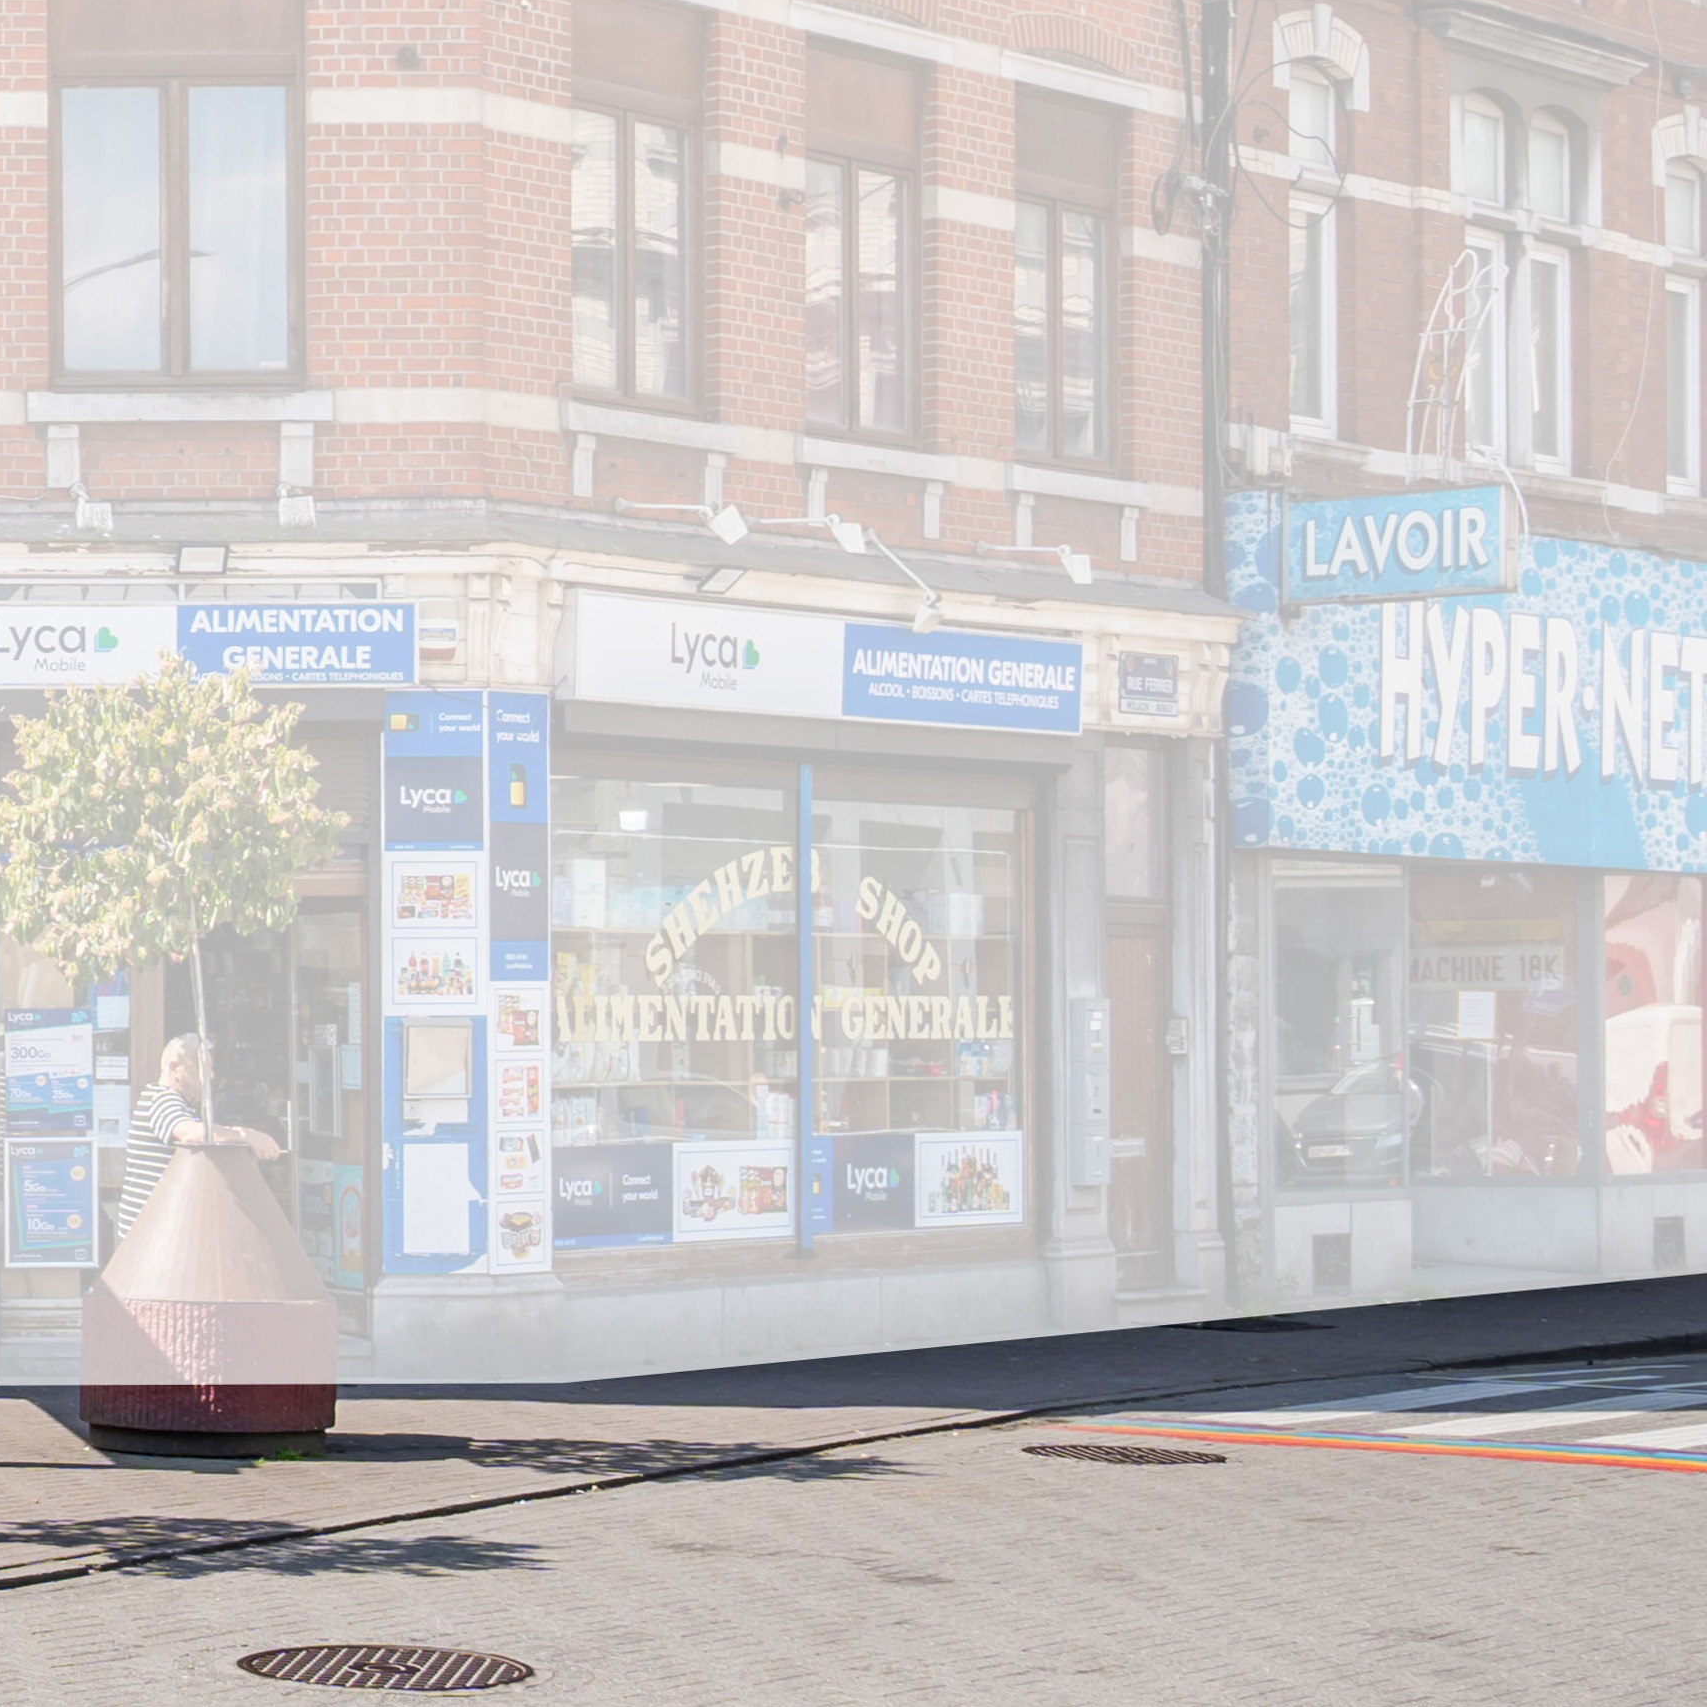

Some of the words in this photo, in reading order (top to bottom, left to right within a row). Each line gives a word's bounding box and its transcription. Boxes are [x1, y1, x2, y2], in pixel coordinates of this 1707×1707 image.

[1303, 506, 1489, 581] LAVOIR
[190, 608, 405, 633] ALIMENTATION
[223, 646, 372, 669] GENERALE
[670, 621, 738, 674] Lyca
[34, 657, 87, 672] Mobile
[852, 649, 984, 683] ALIMENTATION
[988, 660, 1076, 691] GENERALE
[291, 672, 327, 681] CARTES
[329, 672, 405, 681] TELEPHONIQUES
[701, 671, 737, 692] Mobile
[1127, 676, 1143, 691] RUE
[868, 682, 905, 698] ALCOOL
[912, 685, 954, 702] BOISSONS
[961, 689, 992, 705] CARTES
[994, 692, 1059, 709] TELEPHONIQUES
[438, 712, 472, 721] Connect
[496, 709, 530, 723] Connect
[438, 725, 456, 733] your
[459, 723, 481, 732] world
[400, 785, 452, 808] Lyca
[495, 865, 531, 891] Lyca
[855, 875, 942, 985] SHOP
[8, 1012, 33, 1023] Lyca
[842, 995, 1014, 1040] GENERALE
[10, 1046, 51, 1059] 300Go
[10, 1146, 36, 1156] Lyca
[559, 1177, 592, 1197] Lyca
[847, 1163, 887, 1194] Lyca
[27, 1218, 55, 1231] 10Go
